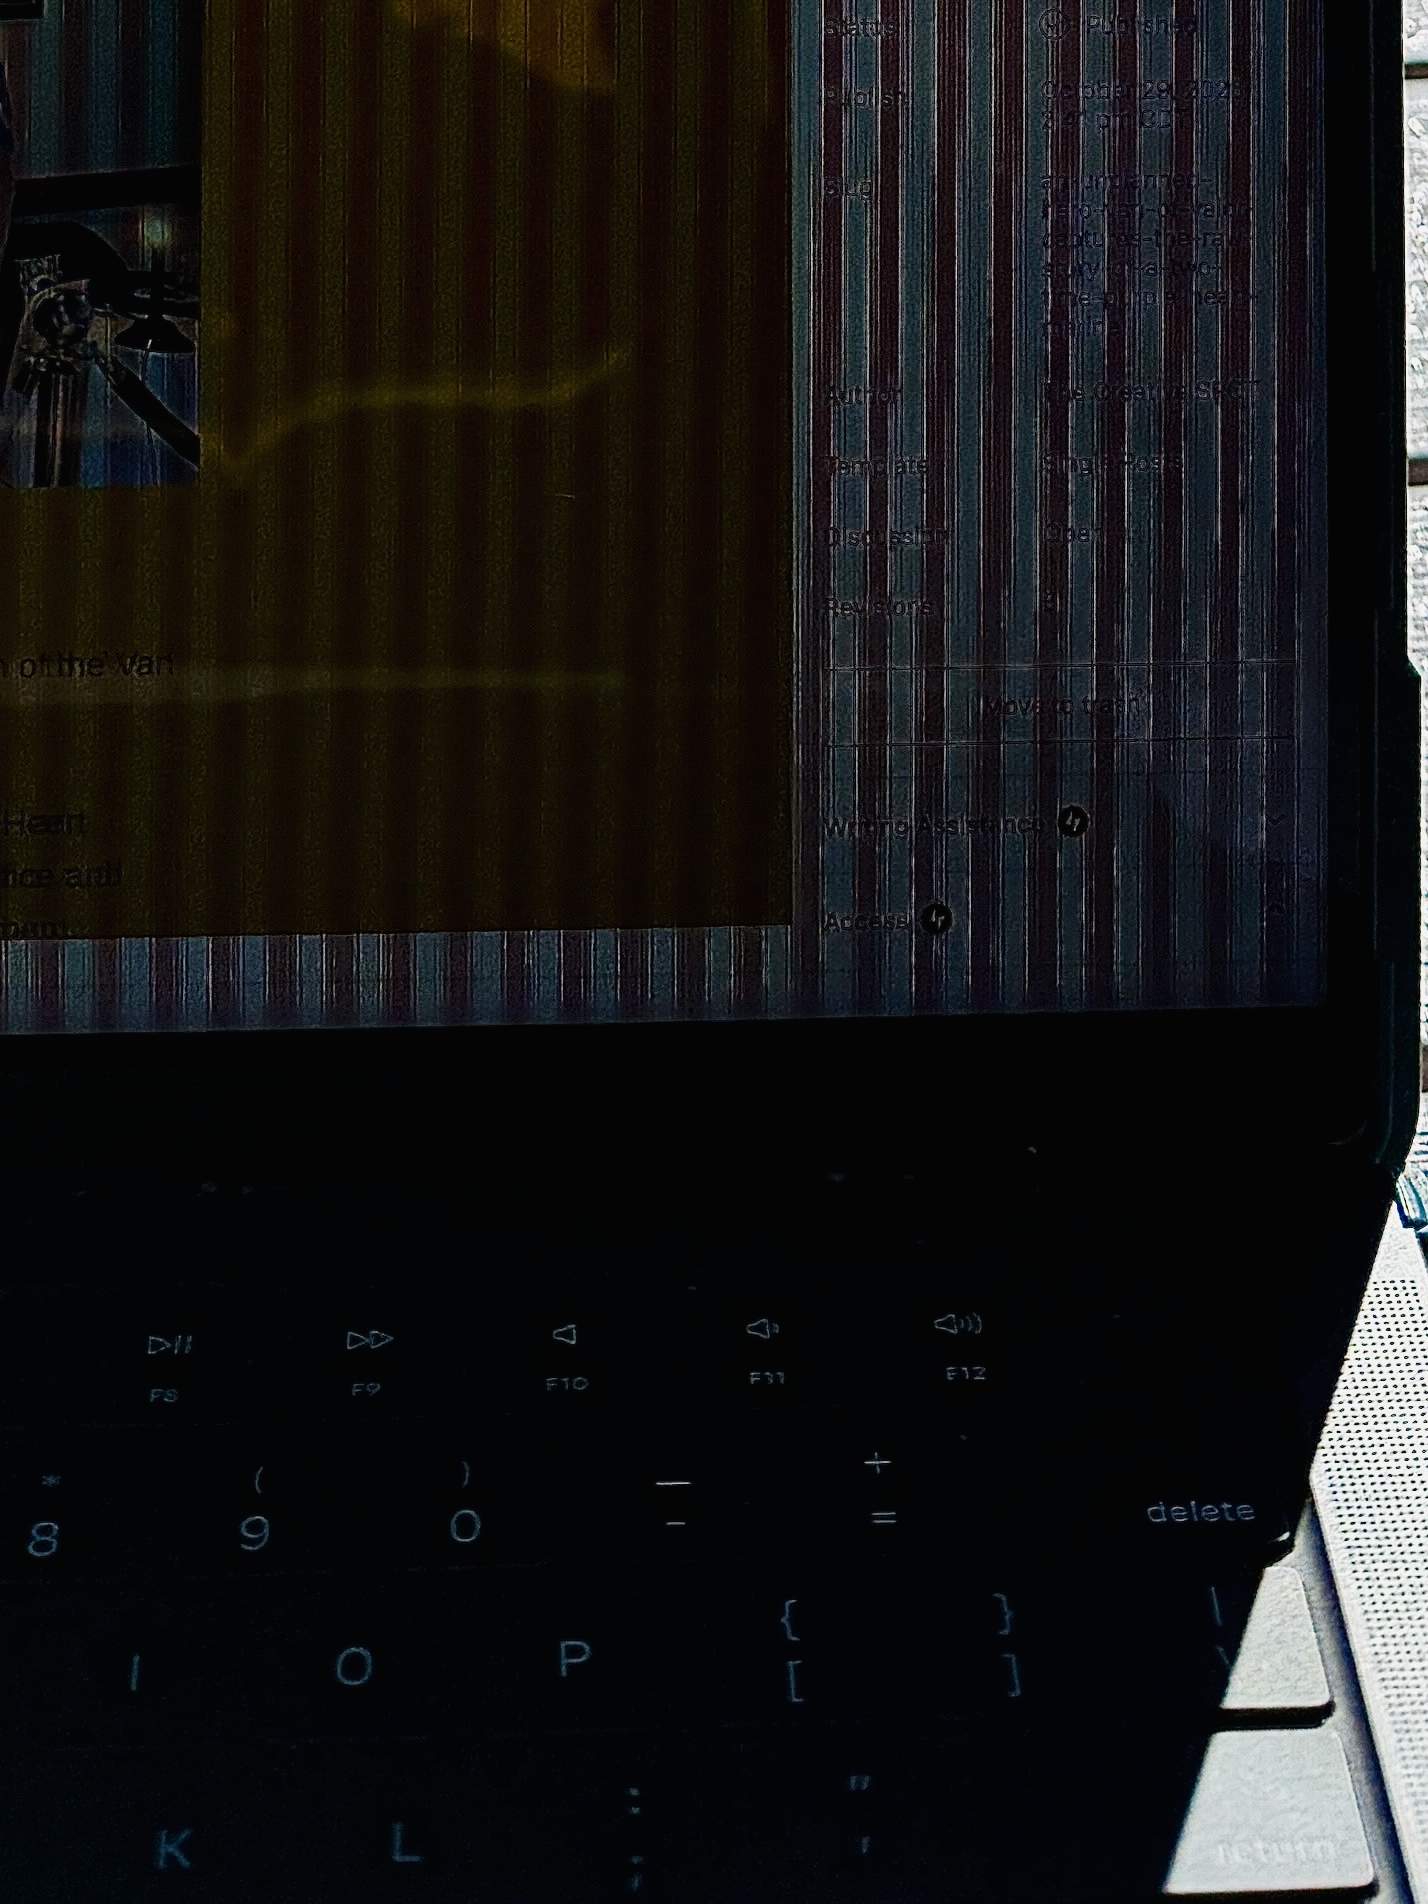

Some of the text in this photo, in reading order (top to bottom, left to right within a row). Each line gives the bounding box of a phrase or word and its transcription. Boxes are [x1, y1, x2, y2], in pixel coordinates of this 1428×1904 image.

[825, 910, 910, 931] Access
[148, 1387, 179, 1404] F8
[349, 1380, 383, 1397] F9
[544, 1375, 590, 1393] F10
[746, 1369, 787, 1386] F11
[944, 1363, 989, 1383] F12
[26, 1519, 63, 1558] 8
[237, 1513, 273, 1553] 9
[1145, 1499, 1257, 1524] delete
[334, 1645, 374, 1687] O
[556, 1639, 594, 1679] P
[151, 1827, 195, 1871] K
[389, 1820, 426, 1864] L
